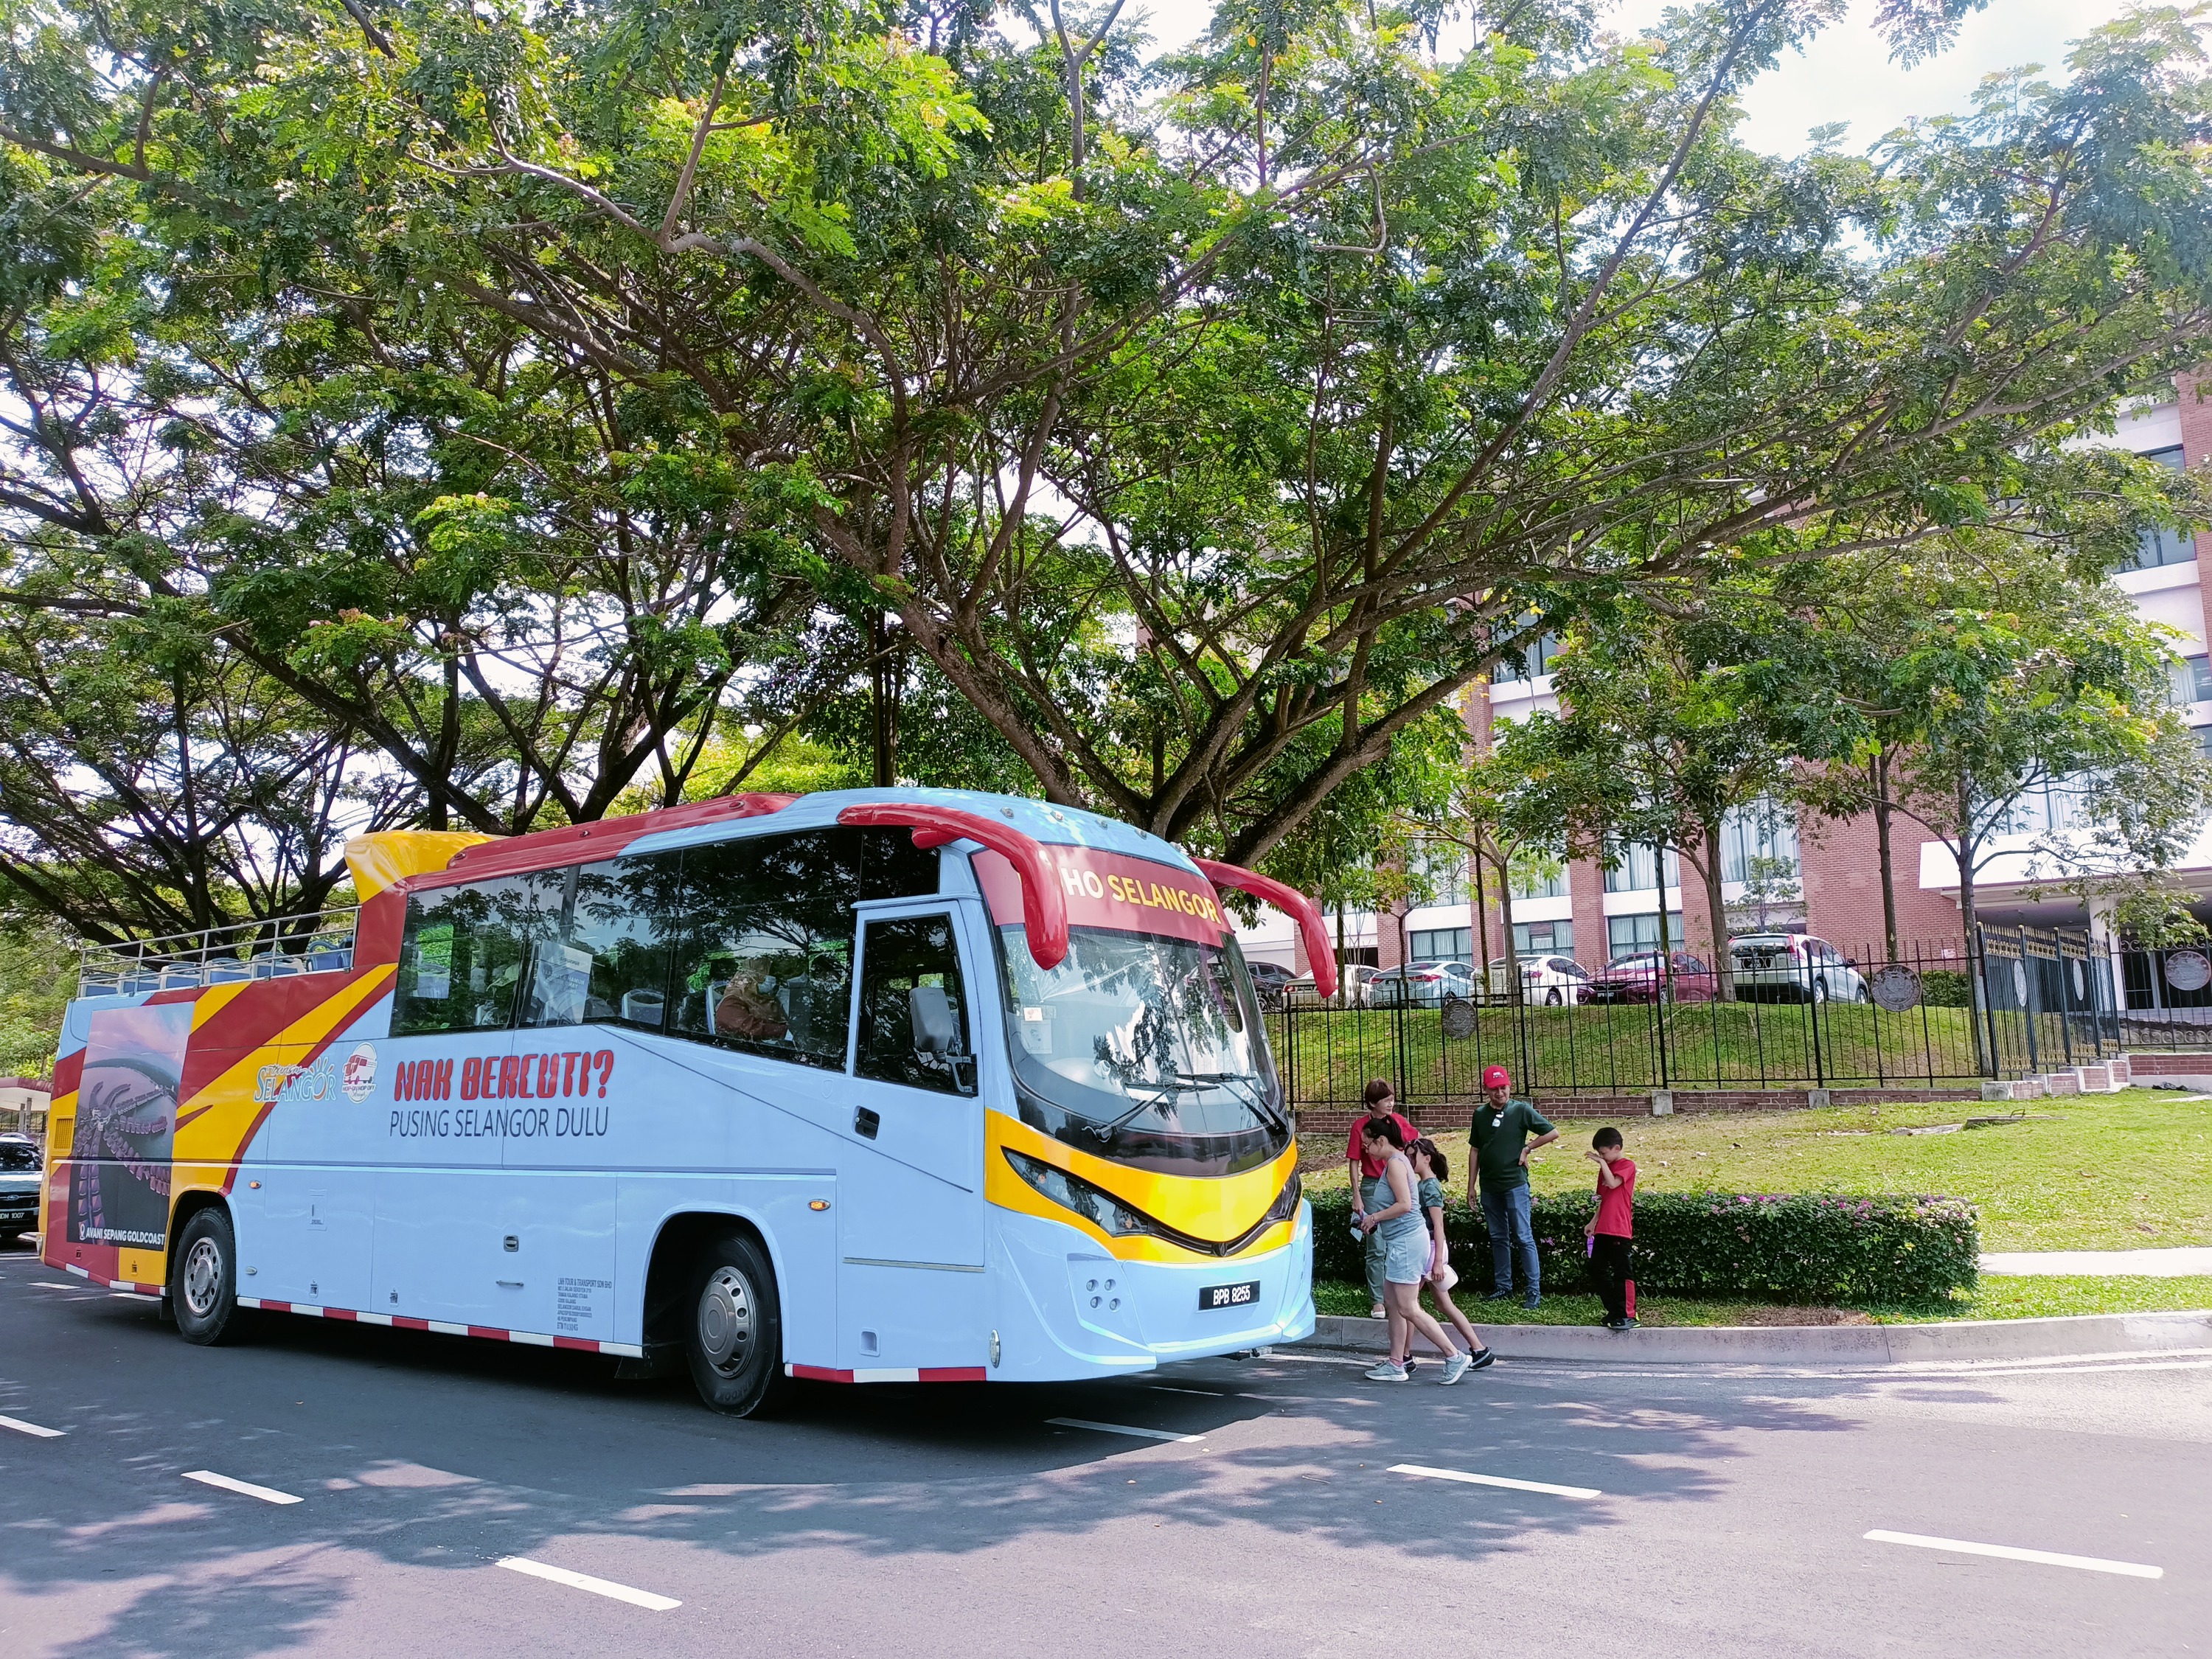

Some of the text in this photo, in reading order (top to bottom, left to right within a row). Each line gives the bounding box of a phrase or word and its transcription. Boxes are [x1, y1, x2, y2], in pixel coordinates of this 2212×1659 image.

[1060, 867, 1222, 925] HO SELANGOR
[254, 1066, 336, 1102] SELANGOR
[394, 1049, 614, 1101] NAK BERCUTI?
[390, 1106, 609, 1137] PUSING SELANGOR DULU
[86, 1227, 165, 1245] AVANI SEPANG GOLDCOAST
[565, 1278, 574, 1286] TOUR
[577, 1279, 597, 1287] TRANSPORT
[1213, 1284, 1251, 1306] BPB 8255
